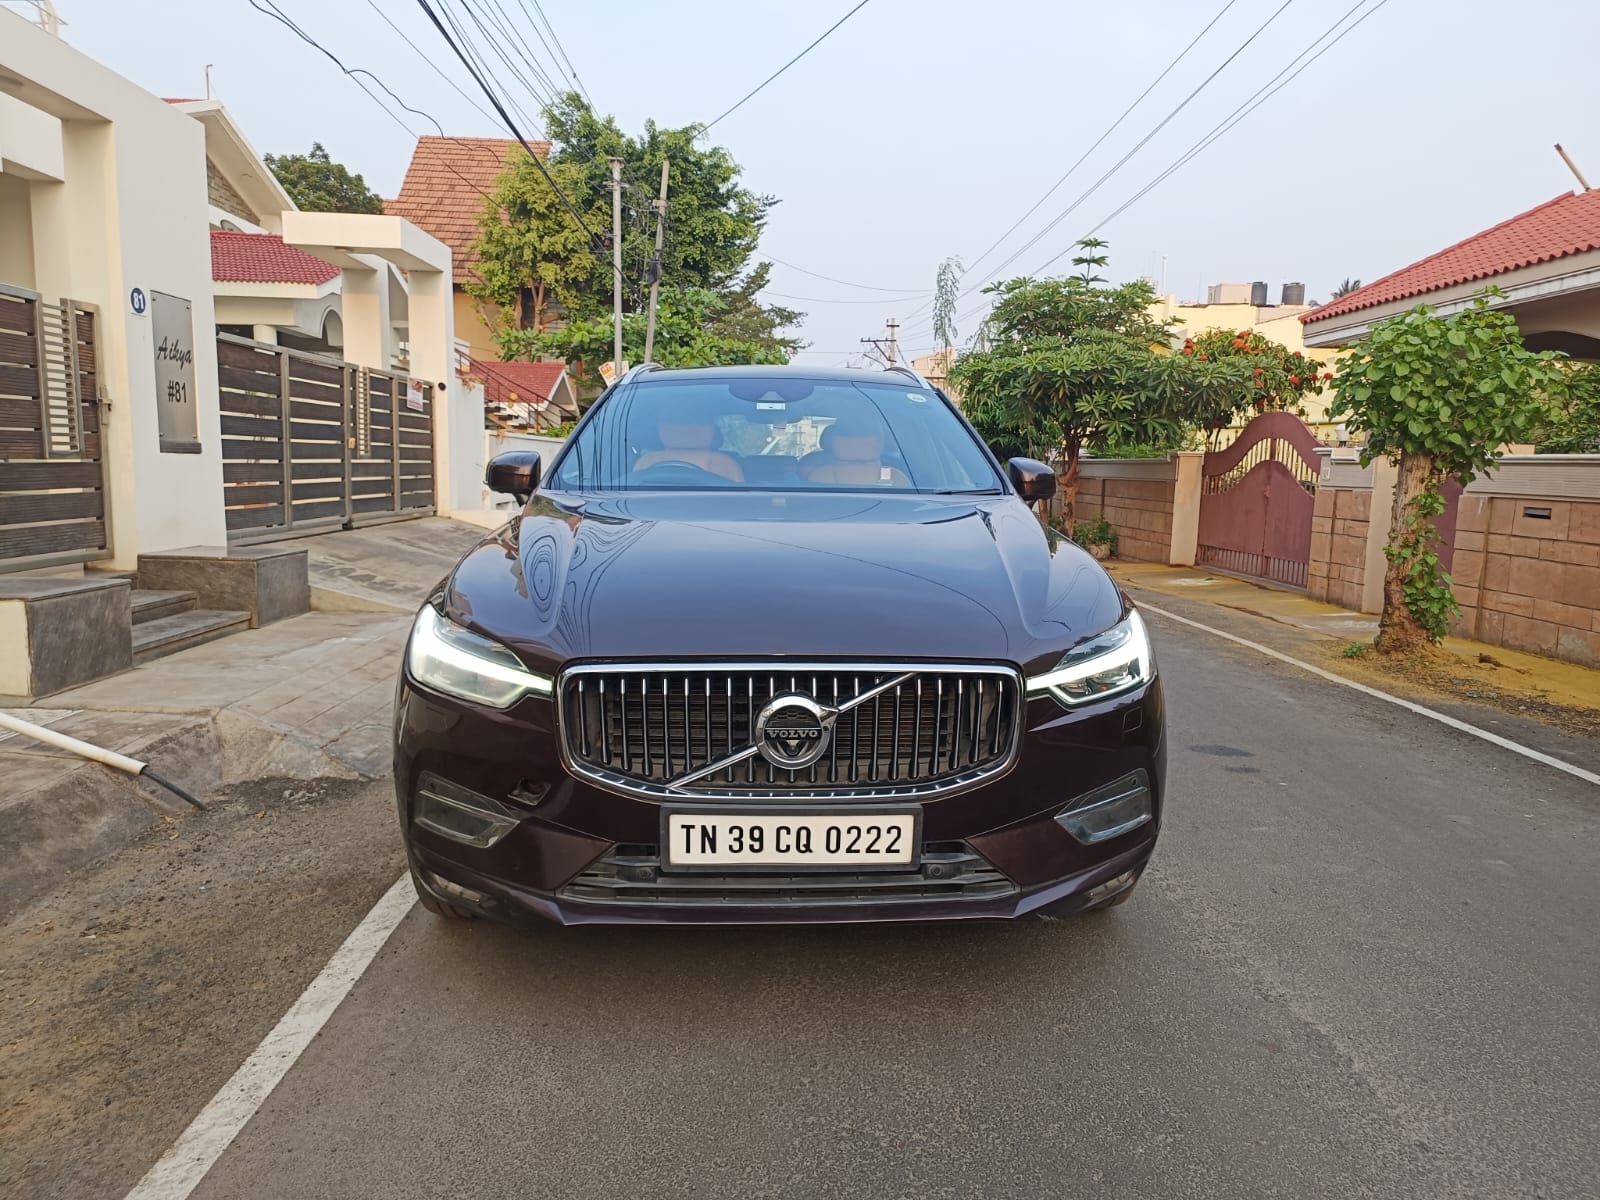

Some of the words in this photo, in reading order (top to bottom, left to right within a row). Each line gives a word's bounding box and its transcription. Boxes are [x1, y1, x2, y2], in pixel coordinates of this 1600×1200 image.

[133, 292, 145, 310] 81
[157, 336, 193, 370] Aikya
[167, 380, 187, 403] #81
[766, 729, 818, 738] VOLVO
[680, 824, 717, 854] TN
[728, 825, 764, 854] 39
[775, 825, 814, 854] CQ
[825, 825, 902, 854] 0222
